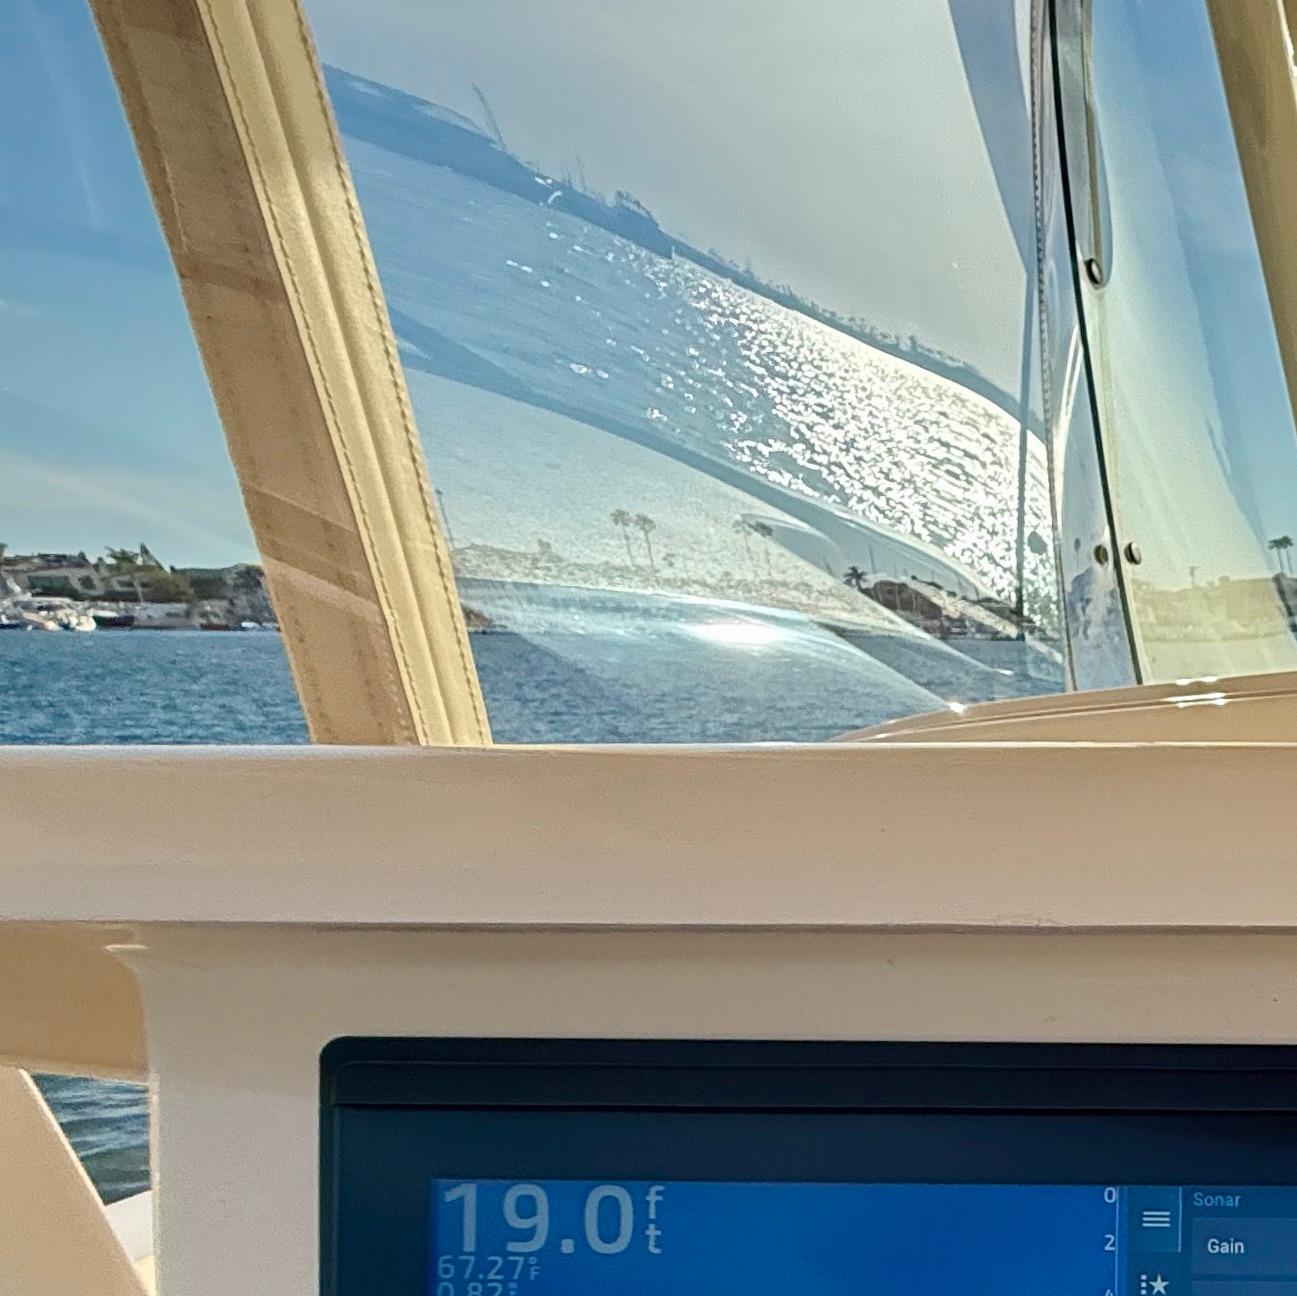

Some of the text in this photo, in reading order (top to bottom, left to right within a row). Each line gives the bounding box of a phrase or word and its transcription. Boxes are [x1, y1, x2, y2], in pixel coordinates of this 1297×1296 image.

[1103, 1187, 1117, 1204] 0
[1193, 1191, 1241, 1208] Sonar
[444, 1183, 634, 1255] 19.0
[1104, 1234, 1116, 1251] 2
[1207, 1238, 1245, 1255] Gain
[437, 1255, 525, 1280] 67.27
